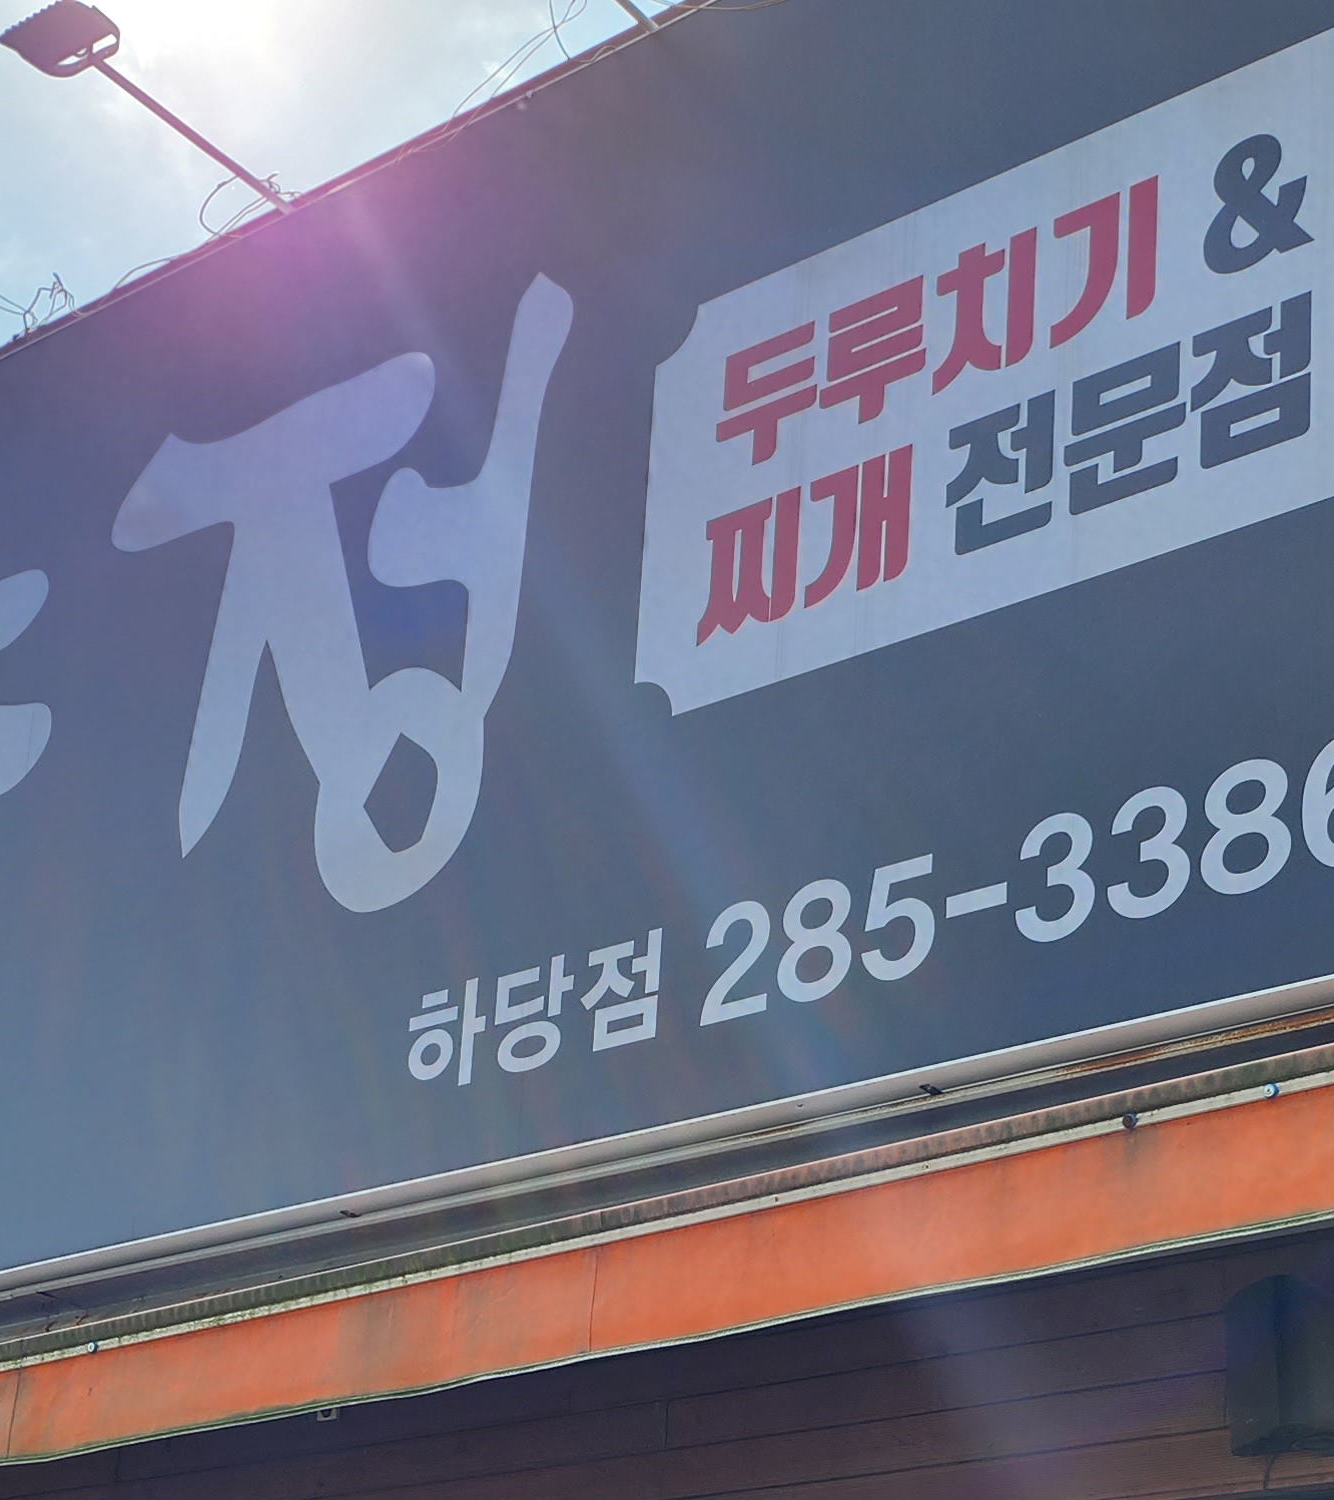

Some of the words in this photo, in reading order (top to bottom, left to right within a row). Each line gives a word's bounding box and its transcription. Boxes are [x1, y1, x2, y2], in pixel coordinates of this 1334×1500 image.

[716, 175, 1159, 465] 두루치기
[1203, 134, 1315, 274] &
[695, 444, 913, 646] 찌개
[945, 290, 1313, 556] 전문점
[407, 928, 663, 1087] 하당점
